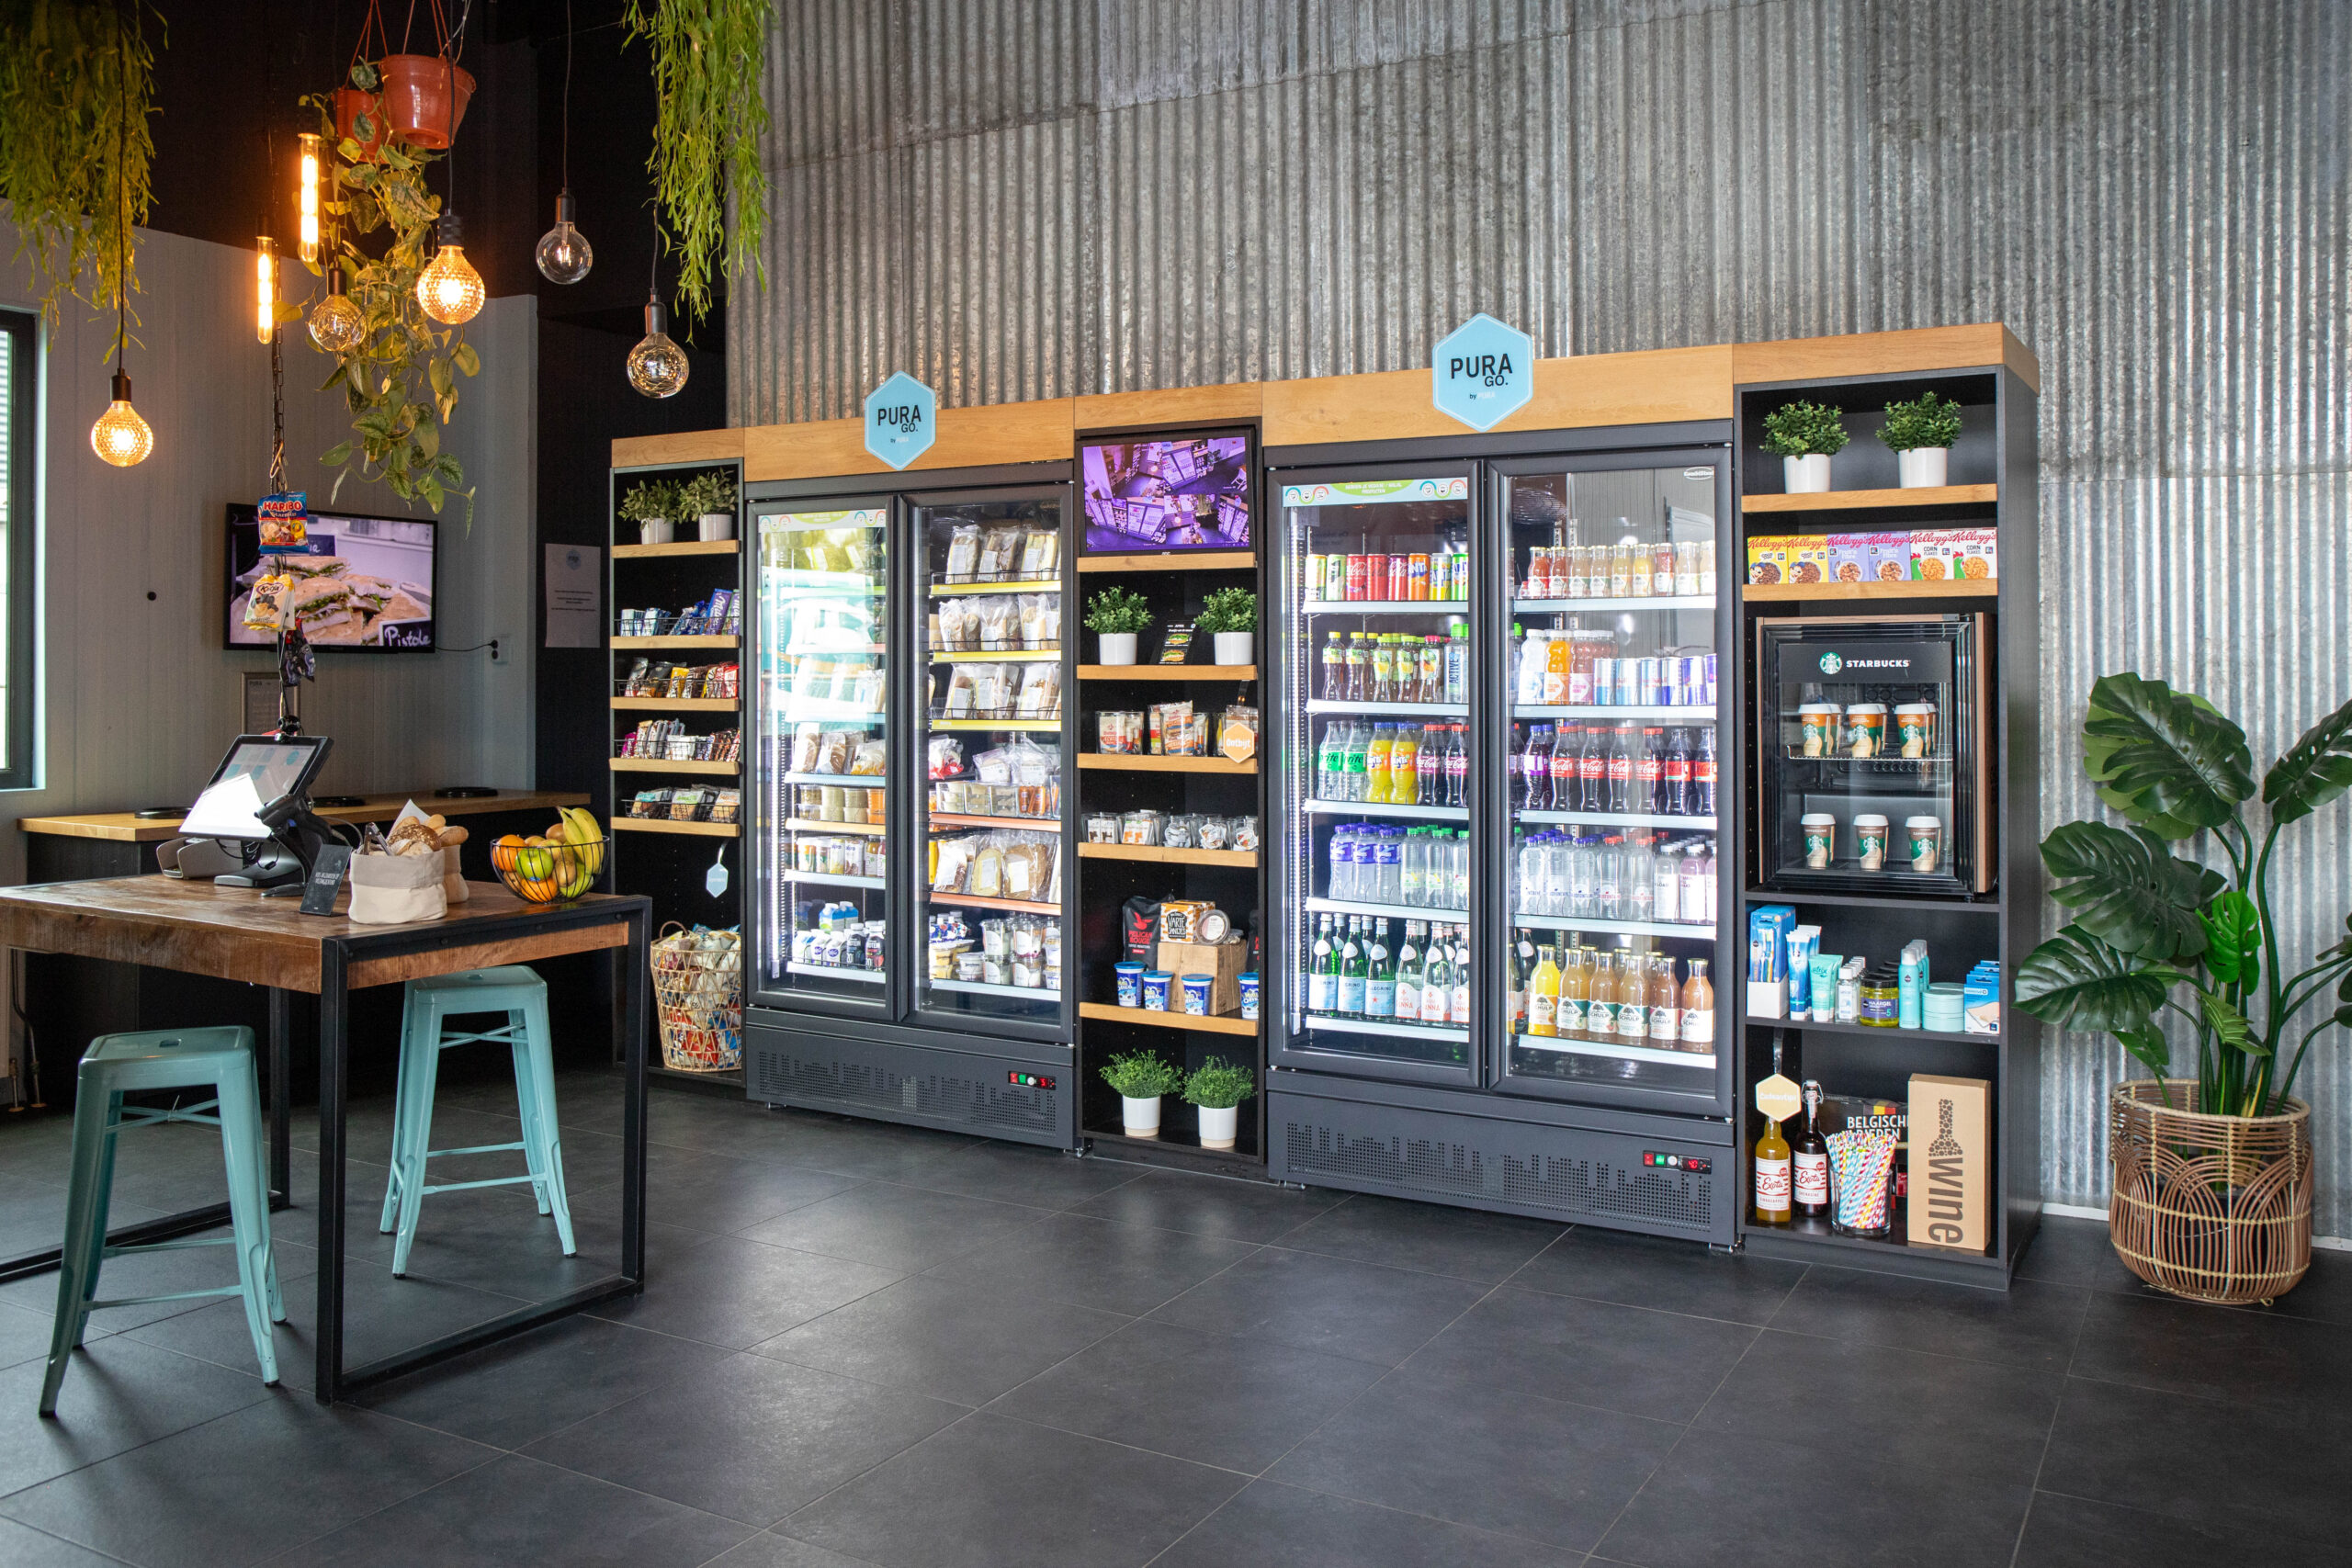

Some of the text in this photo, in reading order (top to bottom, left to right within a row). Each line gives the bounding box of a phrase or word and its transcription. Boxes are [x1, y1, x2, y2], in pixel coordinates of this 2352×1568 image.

[1450, 353, 1513, 379] PURA
[1484, 375, 1509, 387] GO.
[877, 404, 922, 426] PURA
[900, 423, 919, 433] GO.
[263, 501, 303, 511] HARIBO
[1748, 537, 1788, 551] Kellogg's
[1788, 536, 1827, 550] Kellogg's
[1827, 534, 1869, 548] Kellogg's
[1868, 533, 1910, 547] Kellogg's
[1911, 532, 1953, 546] Kellogg's
[1952, 530, 1996, 545] Kellogg's
[1846, 660, 1909, 668] STARBUCKS
[1128, 930, 1153, 938] PELICAN
[1129, 936, 1150, 945] ROUGE
[1847, 1114, 1908, 1129] BELGISCH
[1762, 1177, 1783, 1190] Exota
[1799, 1170, 1820, 1184] Exota
